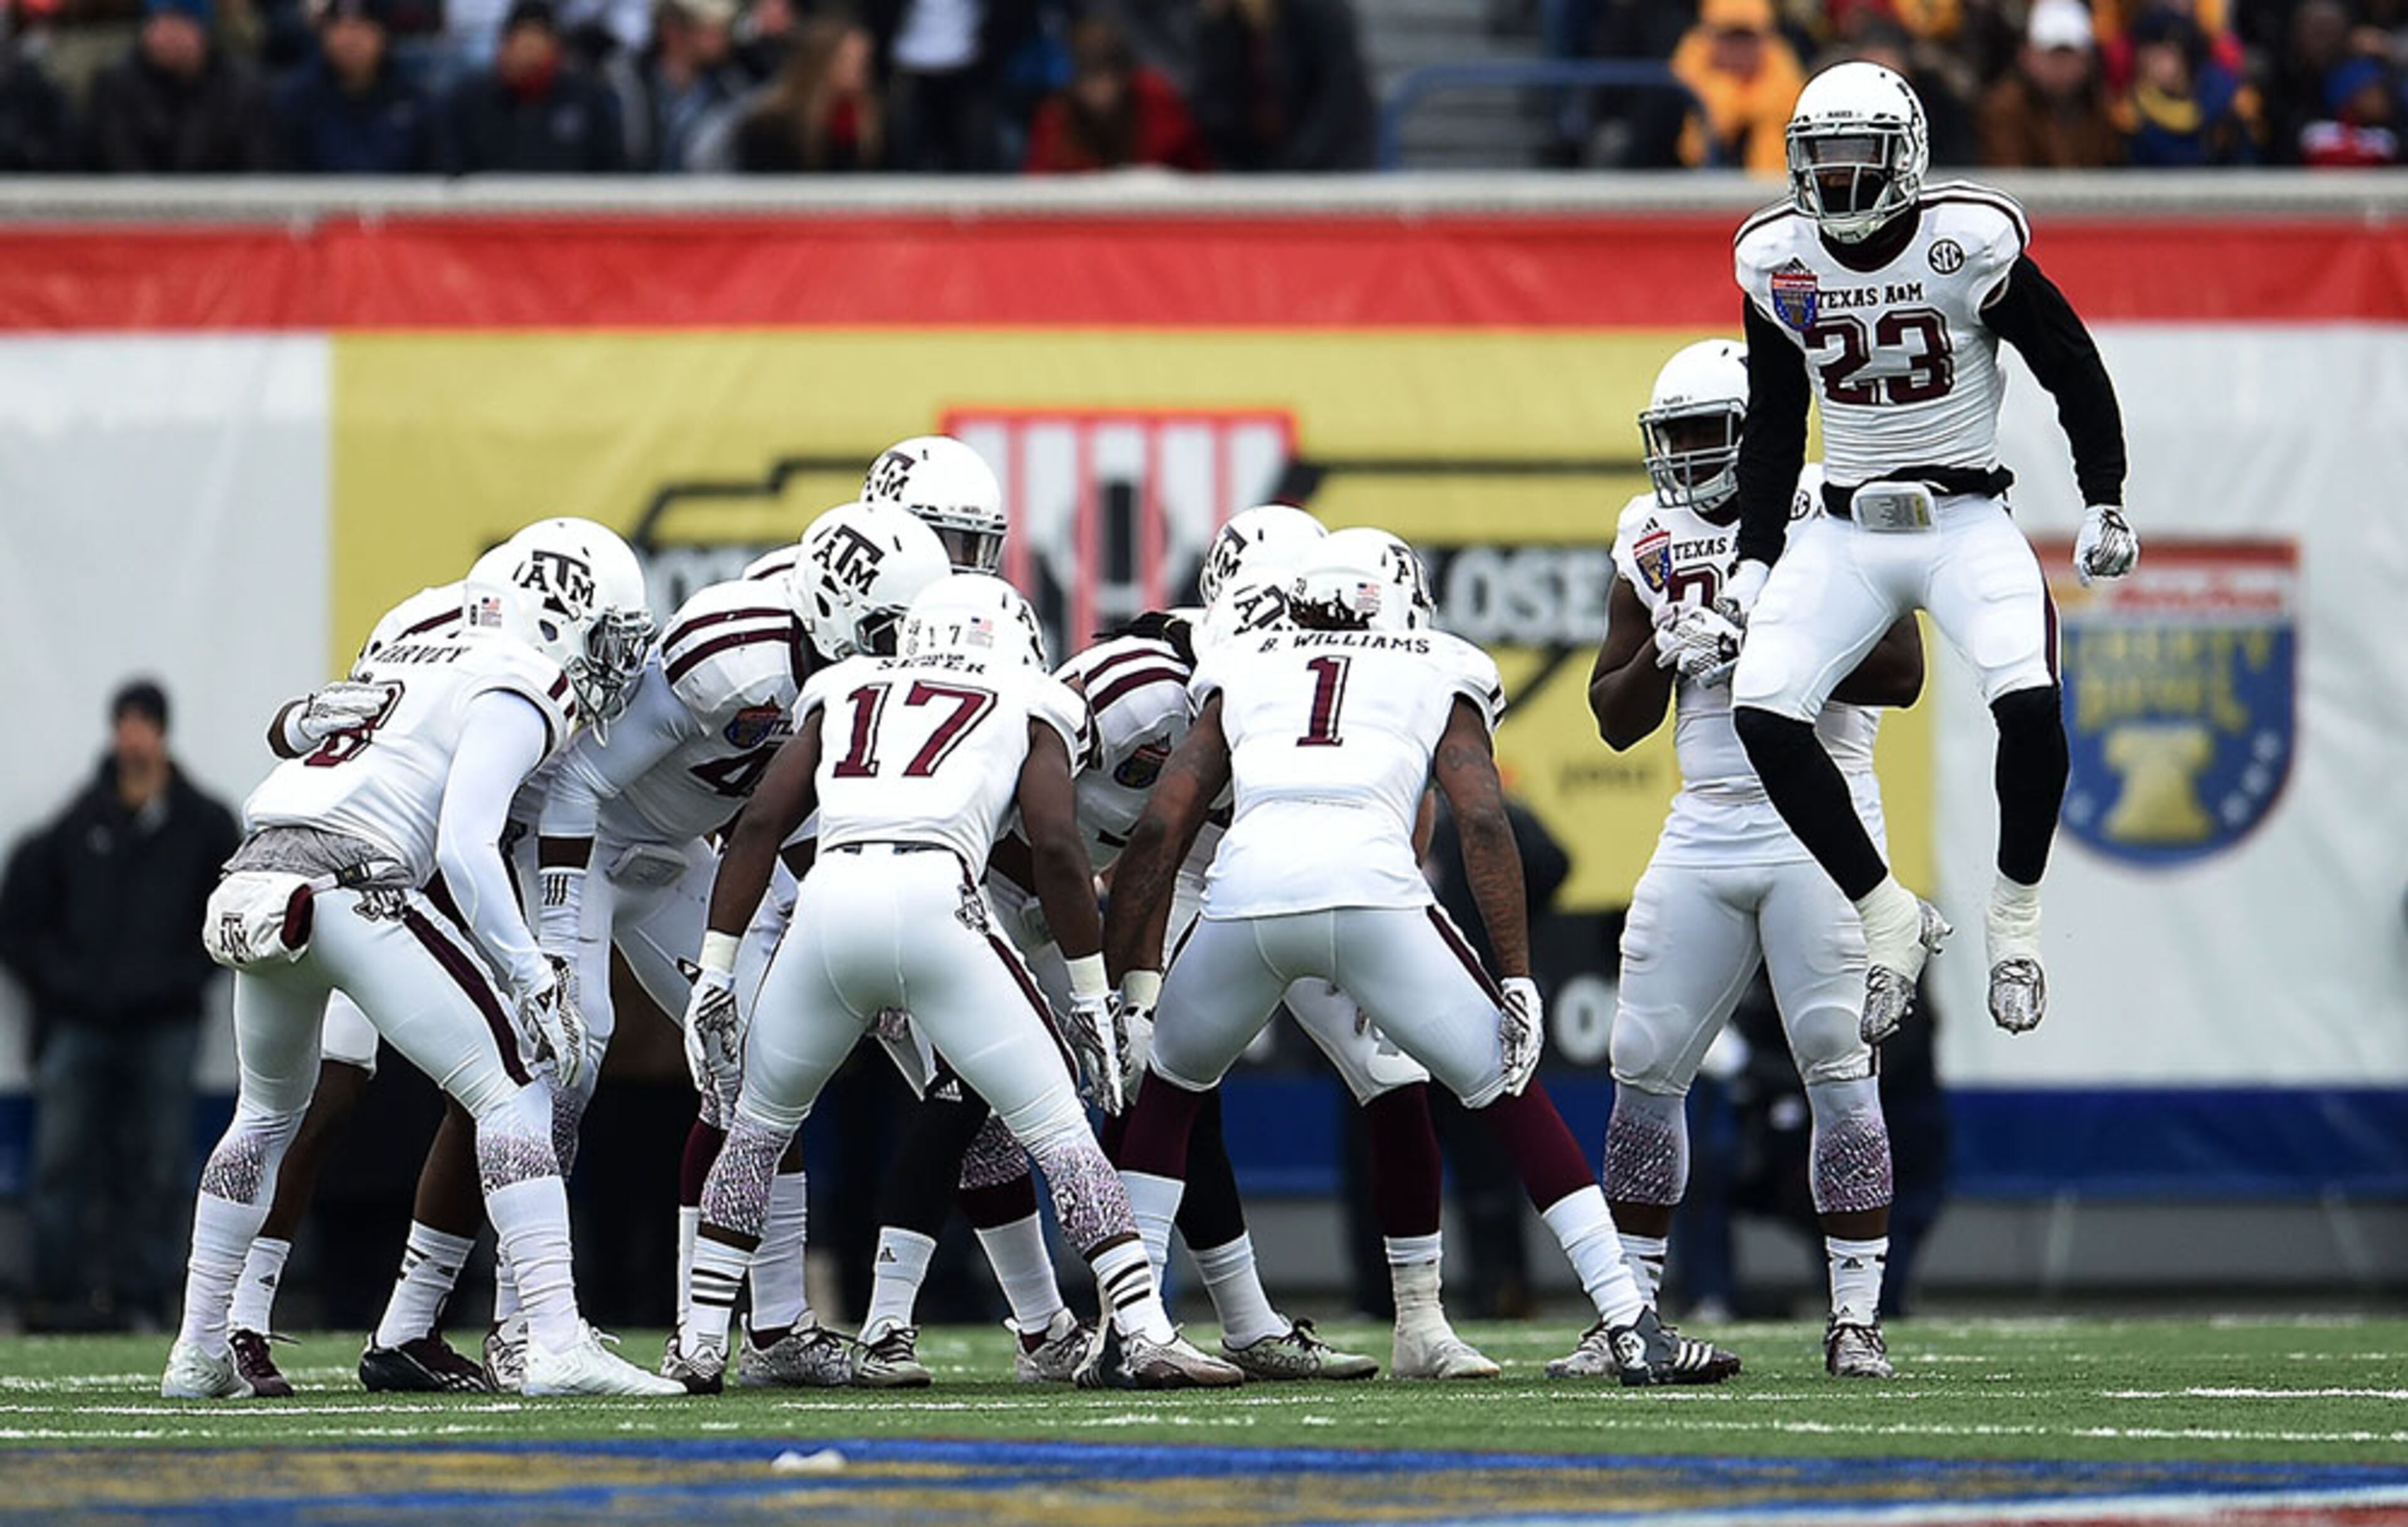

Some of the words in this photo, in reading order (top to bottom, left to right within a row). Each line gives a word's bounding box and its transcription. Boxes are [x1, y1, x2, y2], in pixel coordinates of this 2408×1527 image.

[1817, 287, 1878, 309] TEXAS
[1800, 307, 1954, 405] 23
[1672, 536, 1727, 562] TEXAS
[1433, 543, 1613, 642] OSE
[1293, 632, 1431, 655] WILLIAMS
[2063, 626, 2273, 676] IBERTY
[832, 678, 998, 779] 17
[1296, 655, 1351, 748] 1
